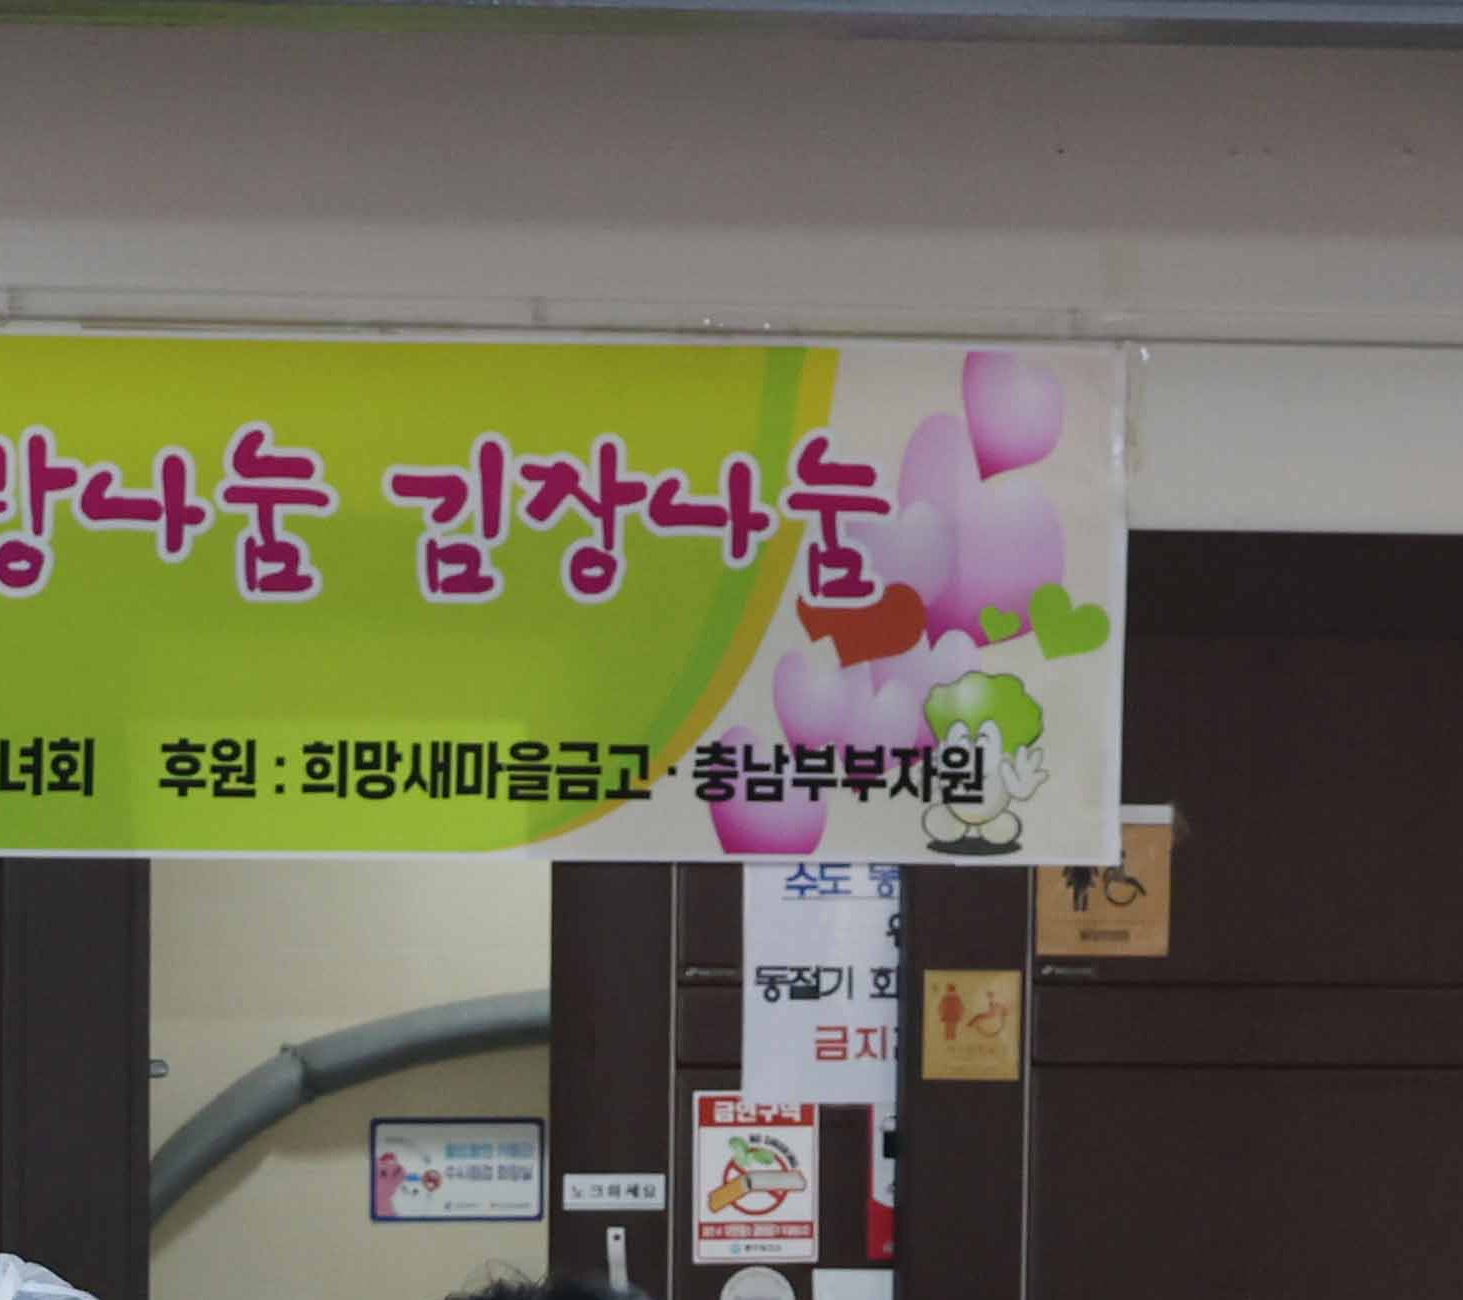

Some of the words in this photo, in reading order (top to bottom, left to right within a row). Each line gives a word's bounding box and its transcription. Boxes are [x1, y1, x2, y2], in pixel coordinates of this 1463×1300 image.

[391, 437, 891, 598] 김장나눔
[302, 740, 653, 801] 희망새마을금고
[784, 863, 852, 897] 수도
[753, 965, 855, 1003] 동절기
